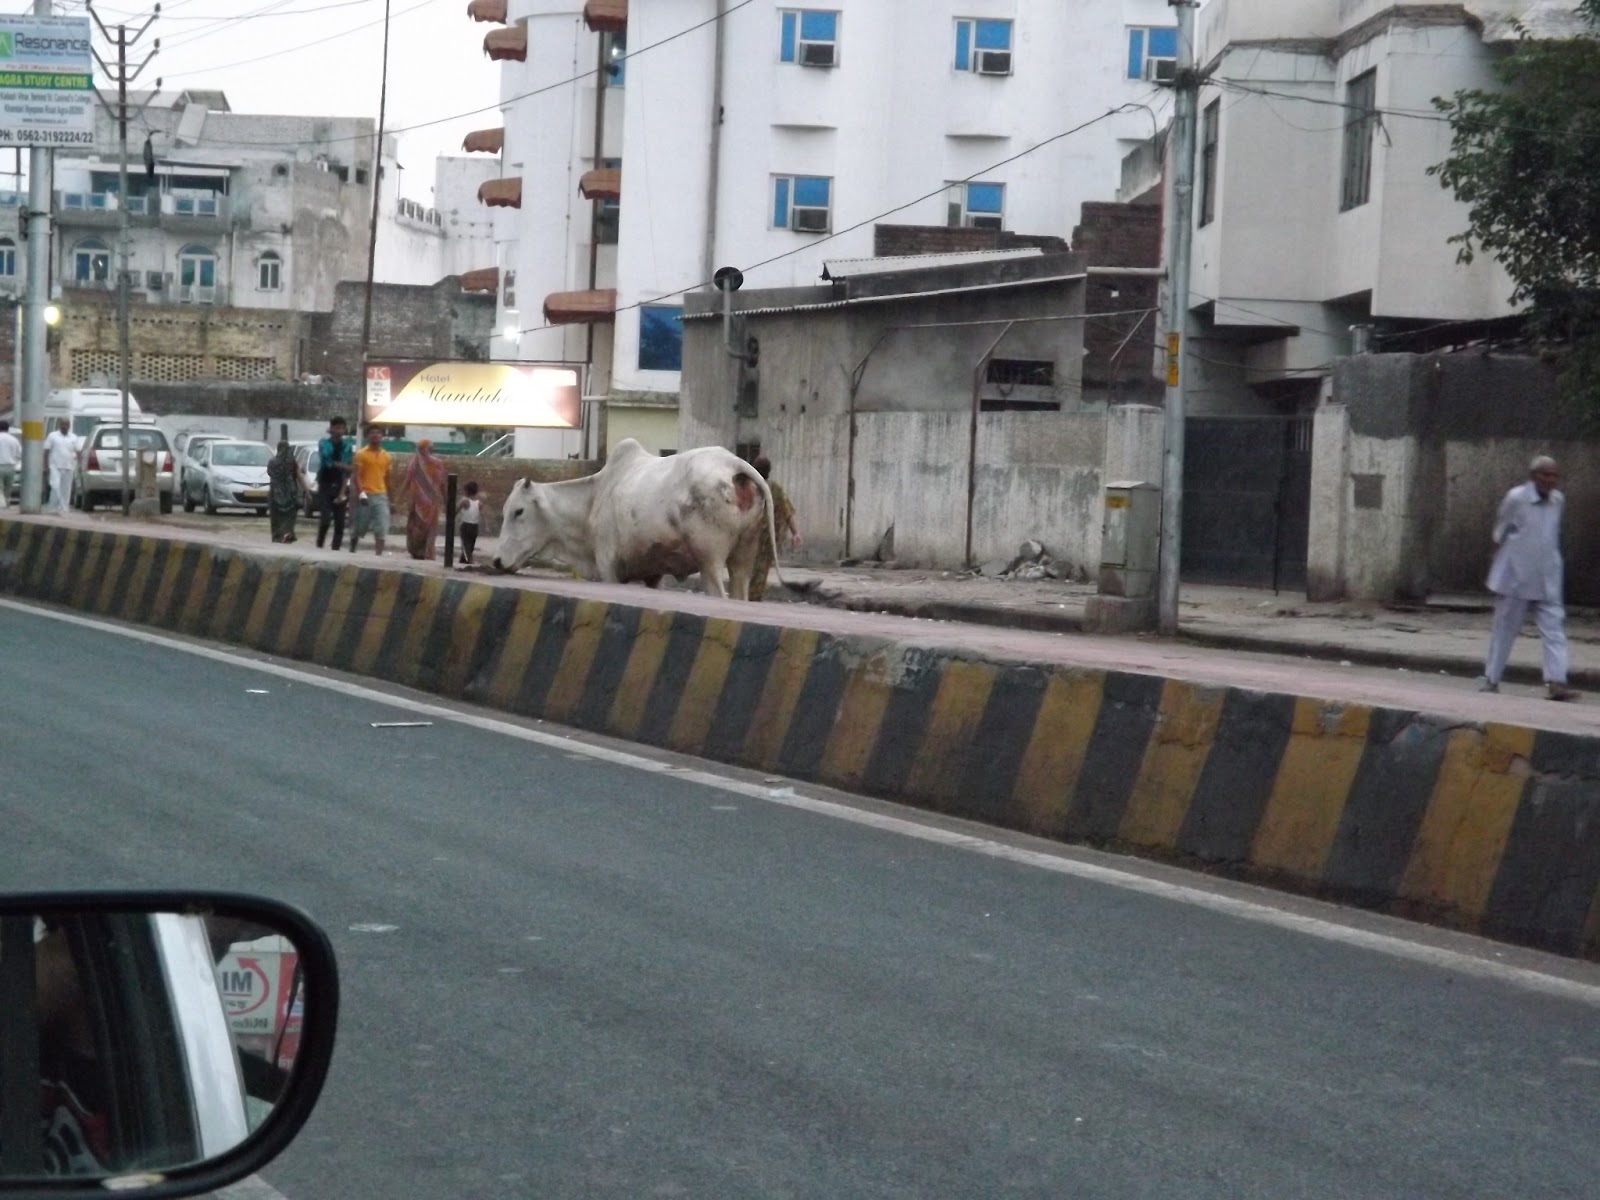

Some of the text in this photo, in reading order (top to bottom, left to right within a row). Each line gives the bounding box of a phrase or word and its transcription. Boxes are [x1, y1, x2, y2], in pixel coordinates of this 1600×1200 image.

[15, 32, 90, 50] Resonance
[0, 73, 89, 88] AGRA STUDY CENTRE
[0, 128, 94, 144] PH: 0562-3192224/22
[420, 374, 450, 383] Hotel
